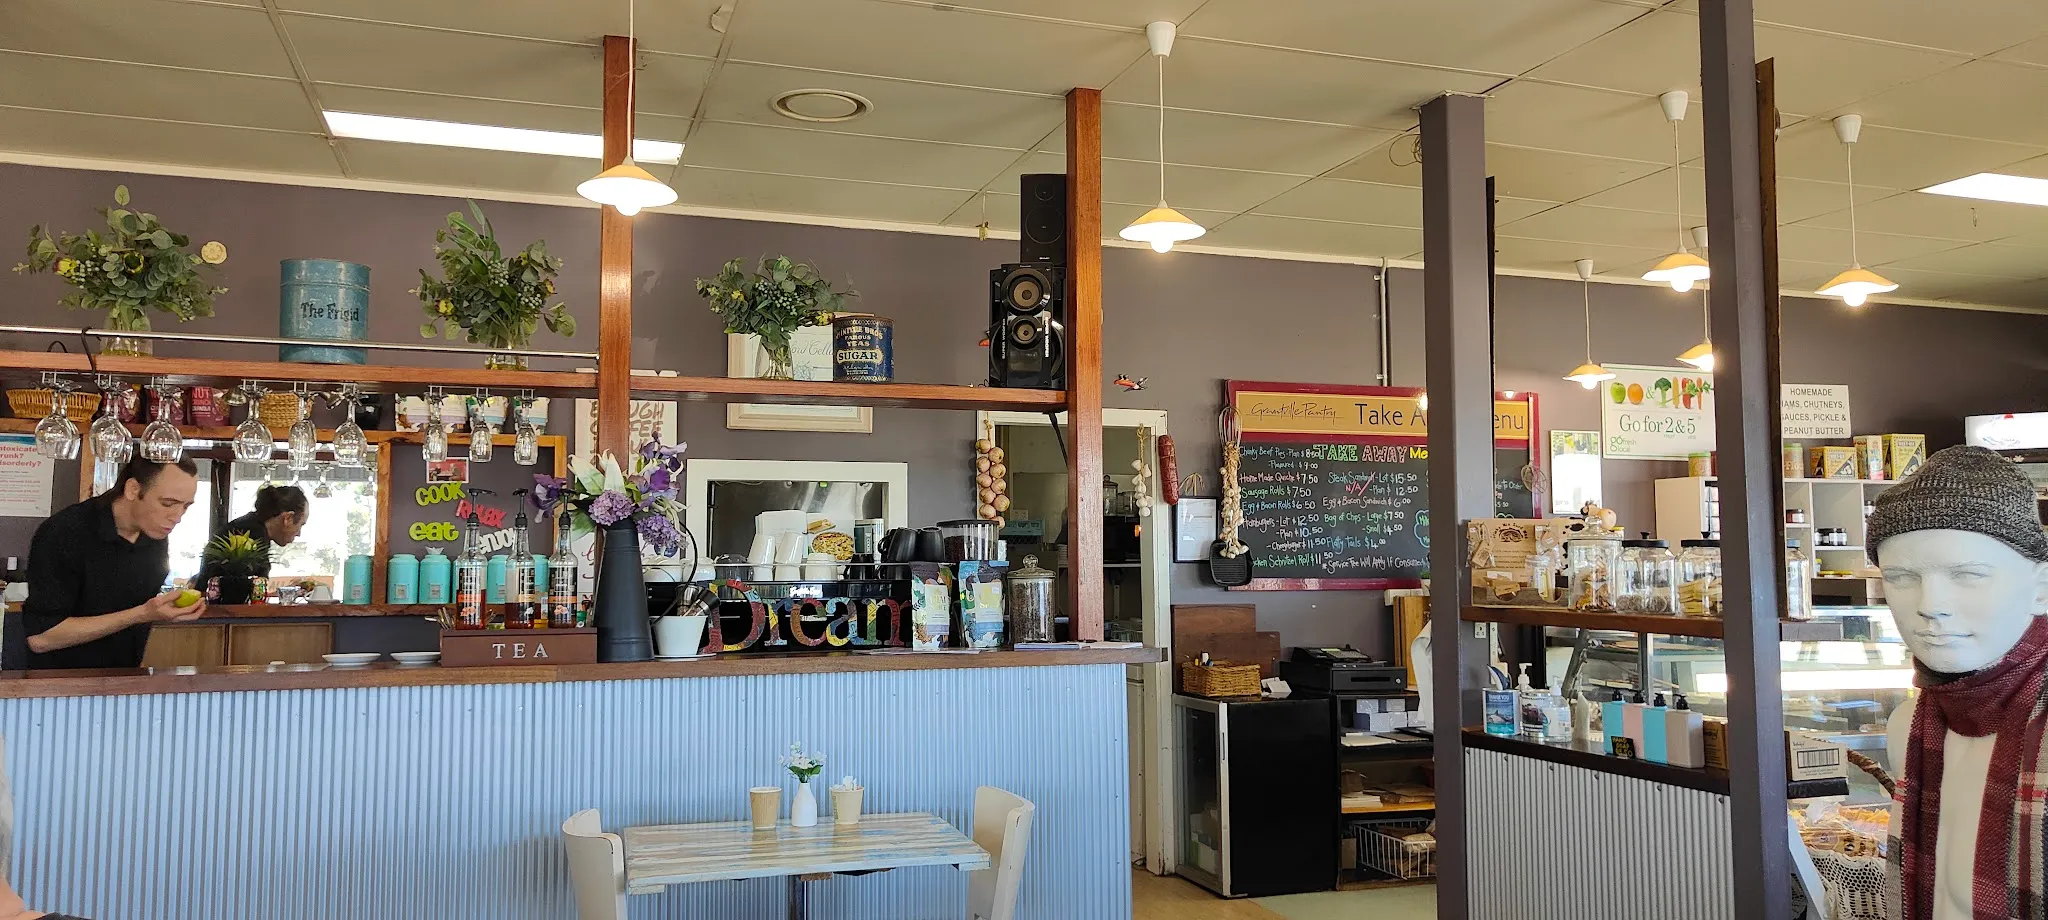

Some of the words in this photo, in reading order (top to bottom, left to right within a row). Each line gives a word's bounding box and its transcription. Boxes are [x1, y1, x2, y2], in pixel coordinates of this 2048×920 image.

[300, 301, 324, 319] The
[326, 302, 360, 322] Frigid
[838, 351, 878, 361] SUGAR
[191, 387, 210, 399] NUT
[1790, 388, 1832, 397] HOMEMADE
[1804, 400, 1845, 410] CHUTNEYS,
[1300, 402, 1337, 425] Pantry
[1354, 403, 1404, 426] Take
[1494, 413, 1524, 429] enu
[1814, 414, 1840, 422] PICKLE
[1842, 414, 1846, 422] &
[1619, 414, 1641, 433] Go
[1643, 415, 1664, 433] for
[1664, 417, 1674, 433] 2
[1675, 419, 1686, 434] &
[1687, 418, 1696, 434] 5
[1784, 427, 1813, 435] PEANUT
[1816, 427, 1844, 435] BUTTER
[1260, 446, 1274, 458] Beef
[1312, 443, 1358, 462] TAKE
[1362, 444, 1408, 463] AWAY
[0, 460, 42, 470] isorderly?
[1240, 472, 1258, 484] Home
[1258, 472, 1274, 483] Made
[1275, 471, 1296, 483] Quiche
[1328, 471, 1348, 484] Steak
[1242, 487, 1268, 500] Sausage
[1270, 485, 1286, 496] Rolls
[1242, 501, 1255, 514] Egg
[1261, 501, 1277, 511] Bacon
[1278, 500, 1292, 511] Rolls
[1322, 496, 1337, 510] Egg
[1342, 496, 1360, 506] Bacon
[1360, 496, 1388, 508] Sandwich
[1242, 516, 1276, 534] Hamburgers
[1324, 513, 1337, 528] Bag
[1338, 512, 1346, 521] of
[1346, 512, 1360, 525] Chips
[409, 521, 460, 542] eat
[1268, 554, 1297, 568] Schnitzel
[1298, 553, 1310, 566] Roll
[1347, 556, 1360, 568] Fee
[1360, 555, 1370, 568] Will
[1372, 556, 1386, 570] Apply
[1386, 556, 1392, 568] If
[492, 643, 549, 660] TEA
